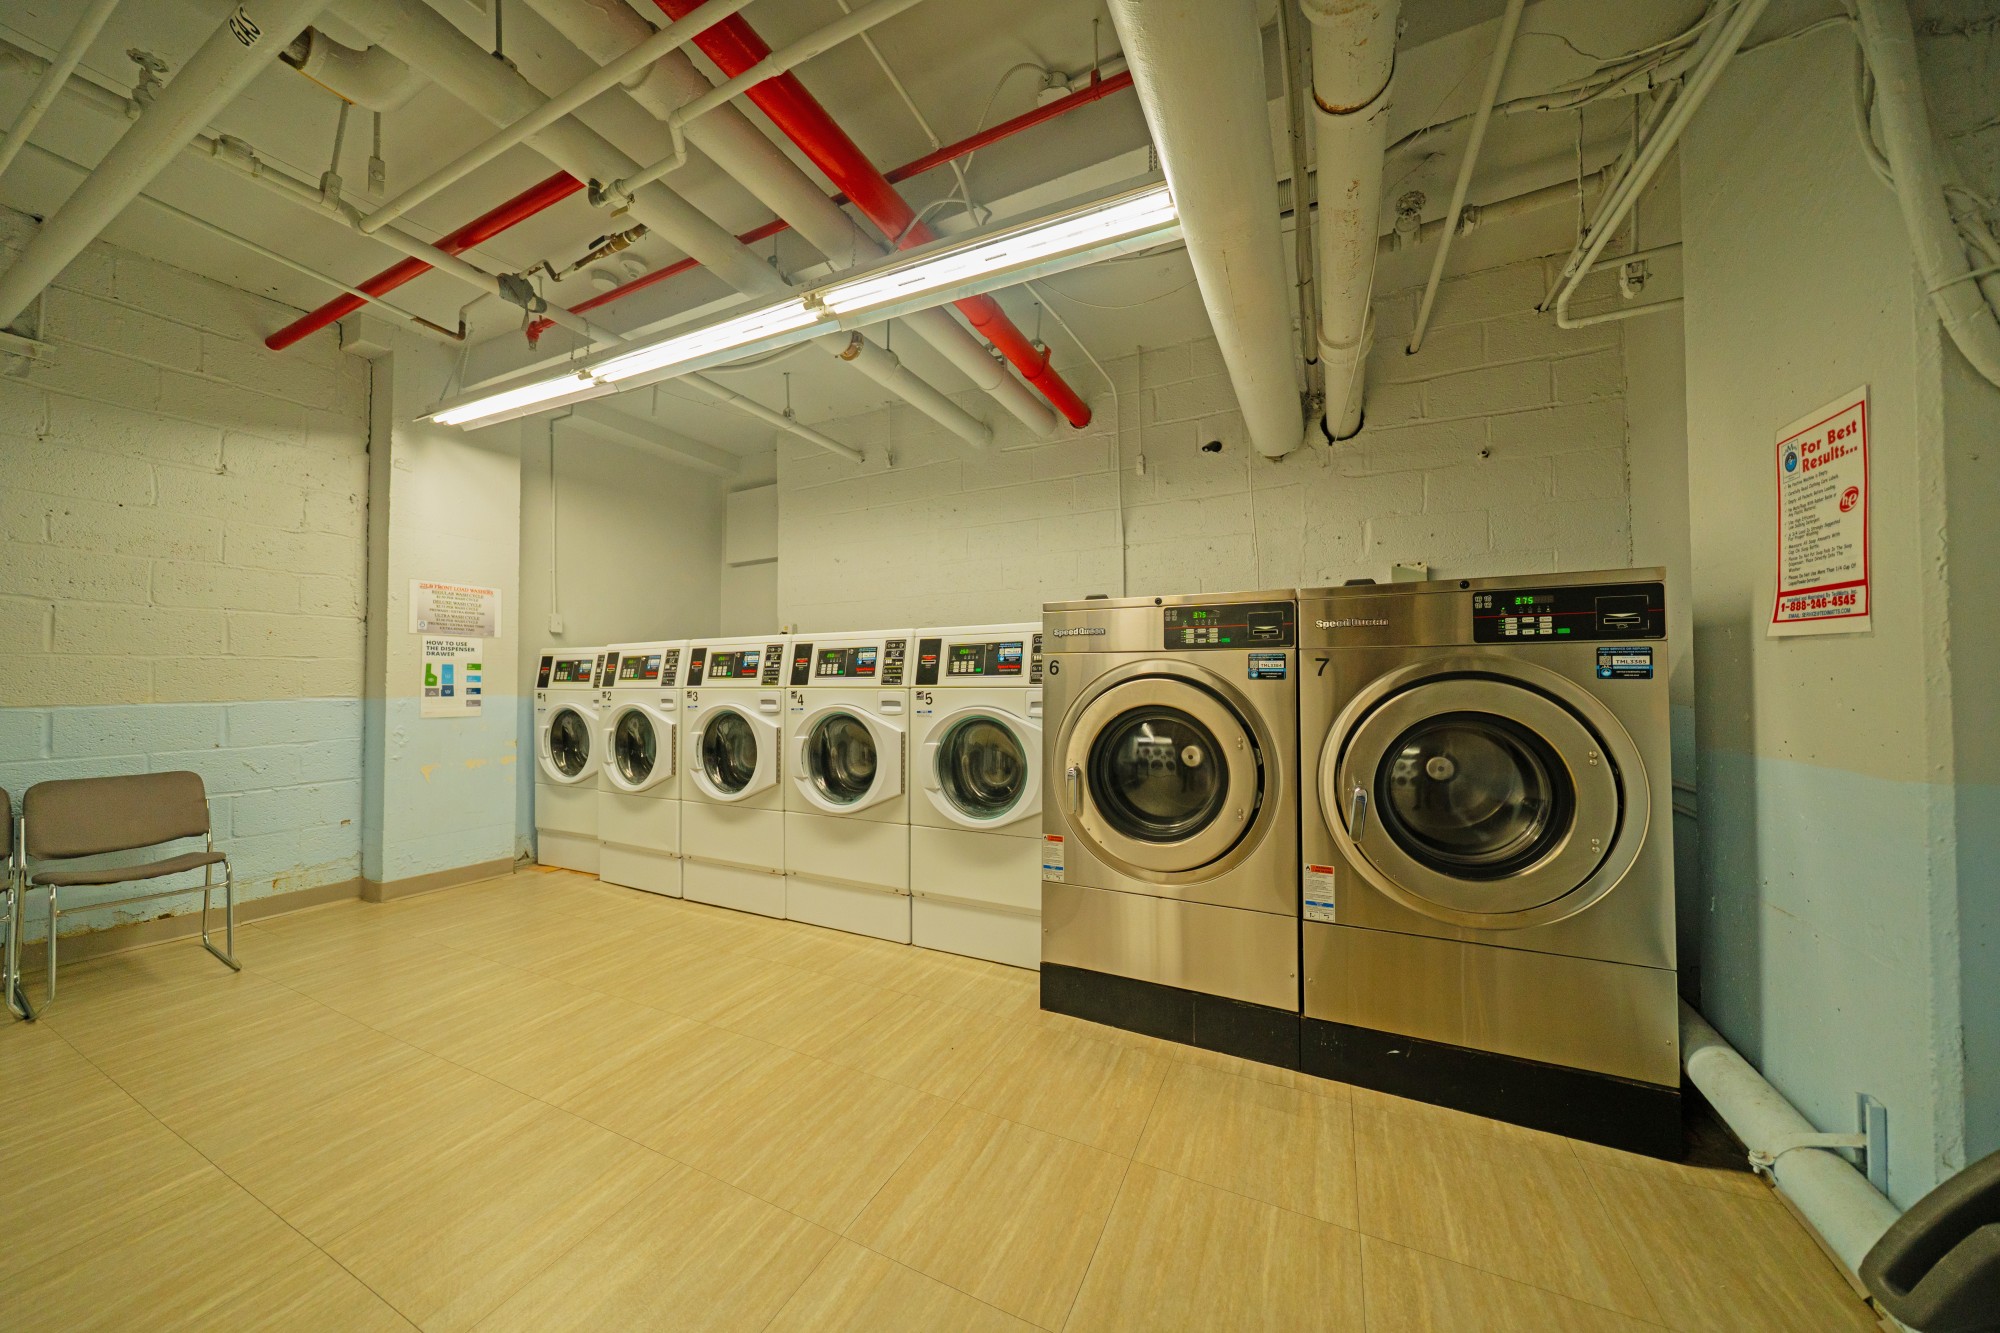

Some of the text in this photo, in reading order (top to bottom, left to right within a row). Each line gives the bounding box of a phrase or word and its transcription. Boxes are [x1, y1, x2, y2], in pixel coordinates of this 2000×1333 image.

[229, 7, 260, 46] GAS
[1801, 439, 1821, 457] For
[1827, 419, 1857, 445] Best
[1802, 445, 1857, 472] Results...
[1842, 493, 1857, 507] he
[1781, 594, 1855, 612] 1-888-246-4545
[1315, 618, 1351, 630] Speed
[1053, 628, 1078, 637] Speed
[1049, 660, 1059, 675] 6
[1315, 657, 1330, 676] 7
[542, 693, 546, 702] 1
[607, 691, 612, 700] 2
[693, 691, 698, 702] 3
[797, 694, 804, 705] 4
[925, 692, 933, 705] 5
